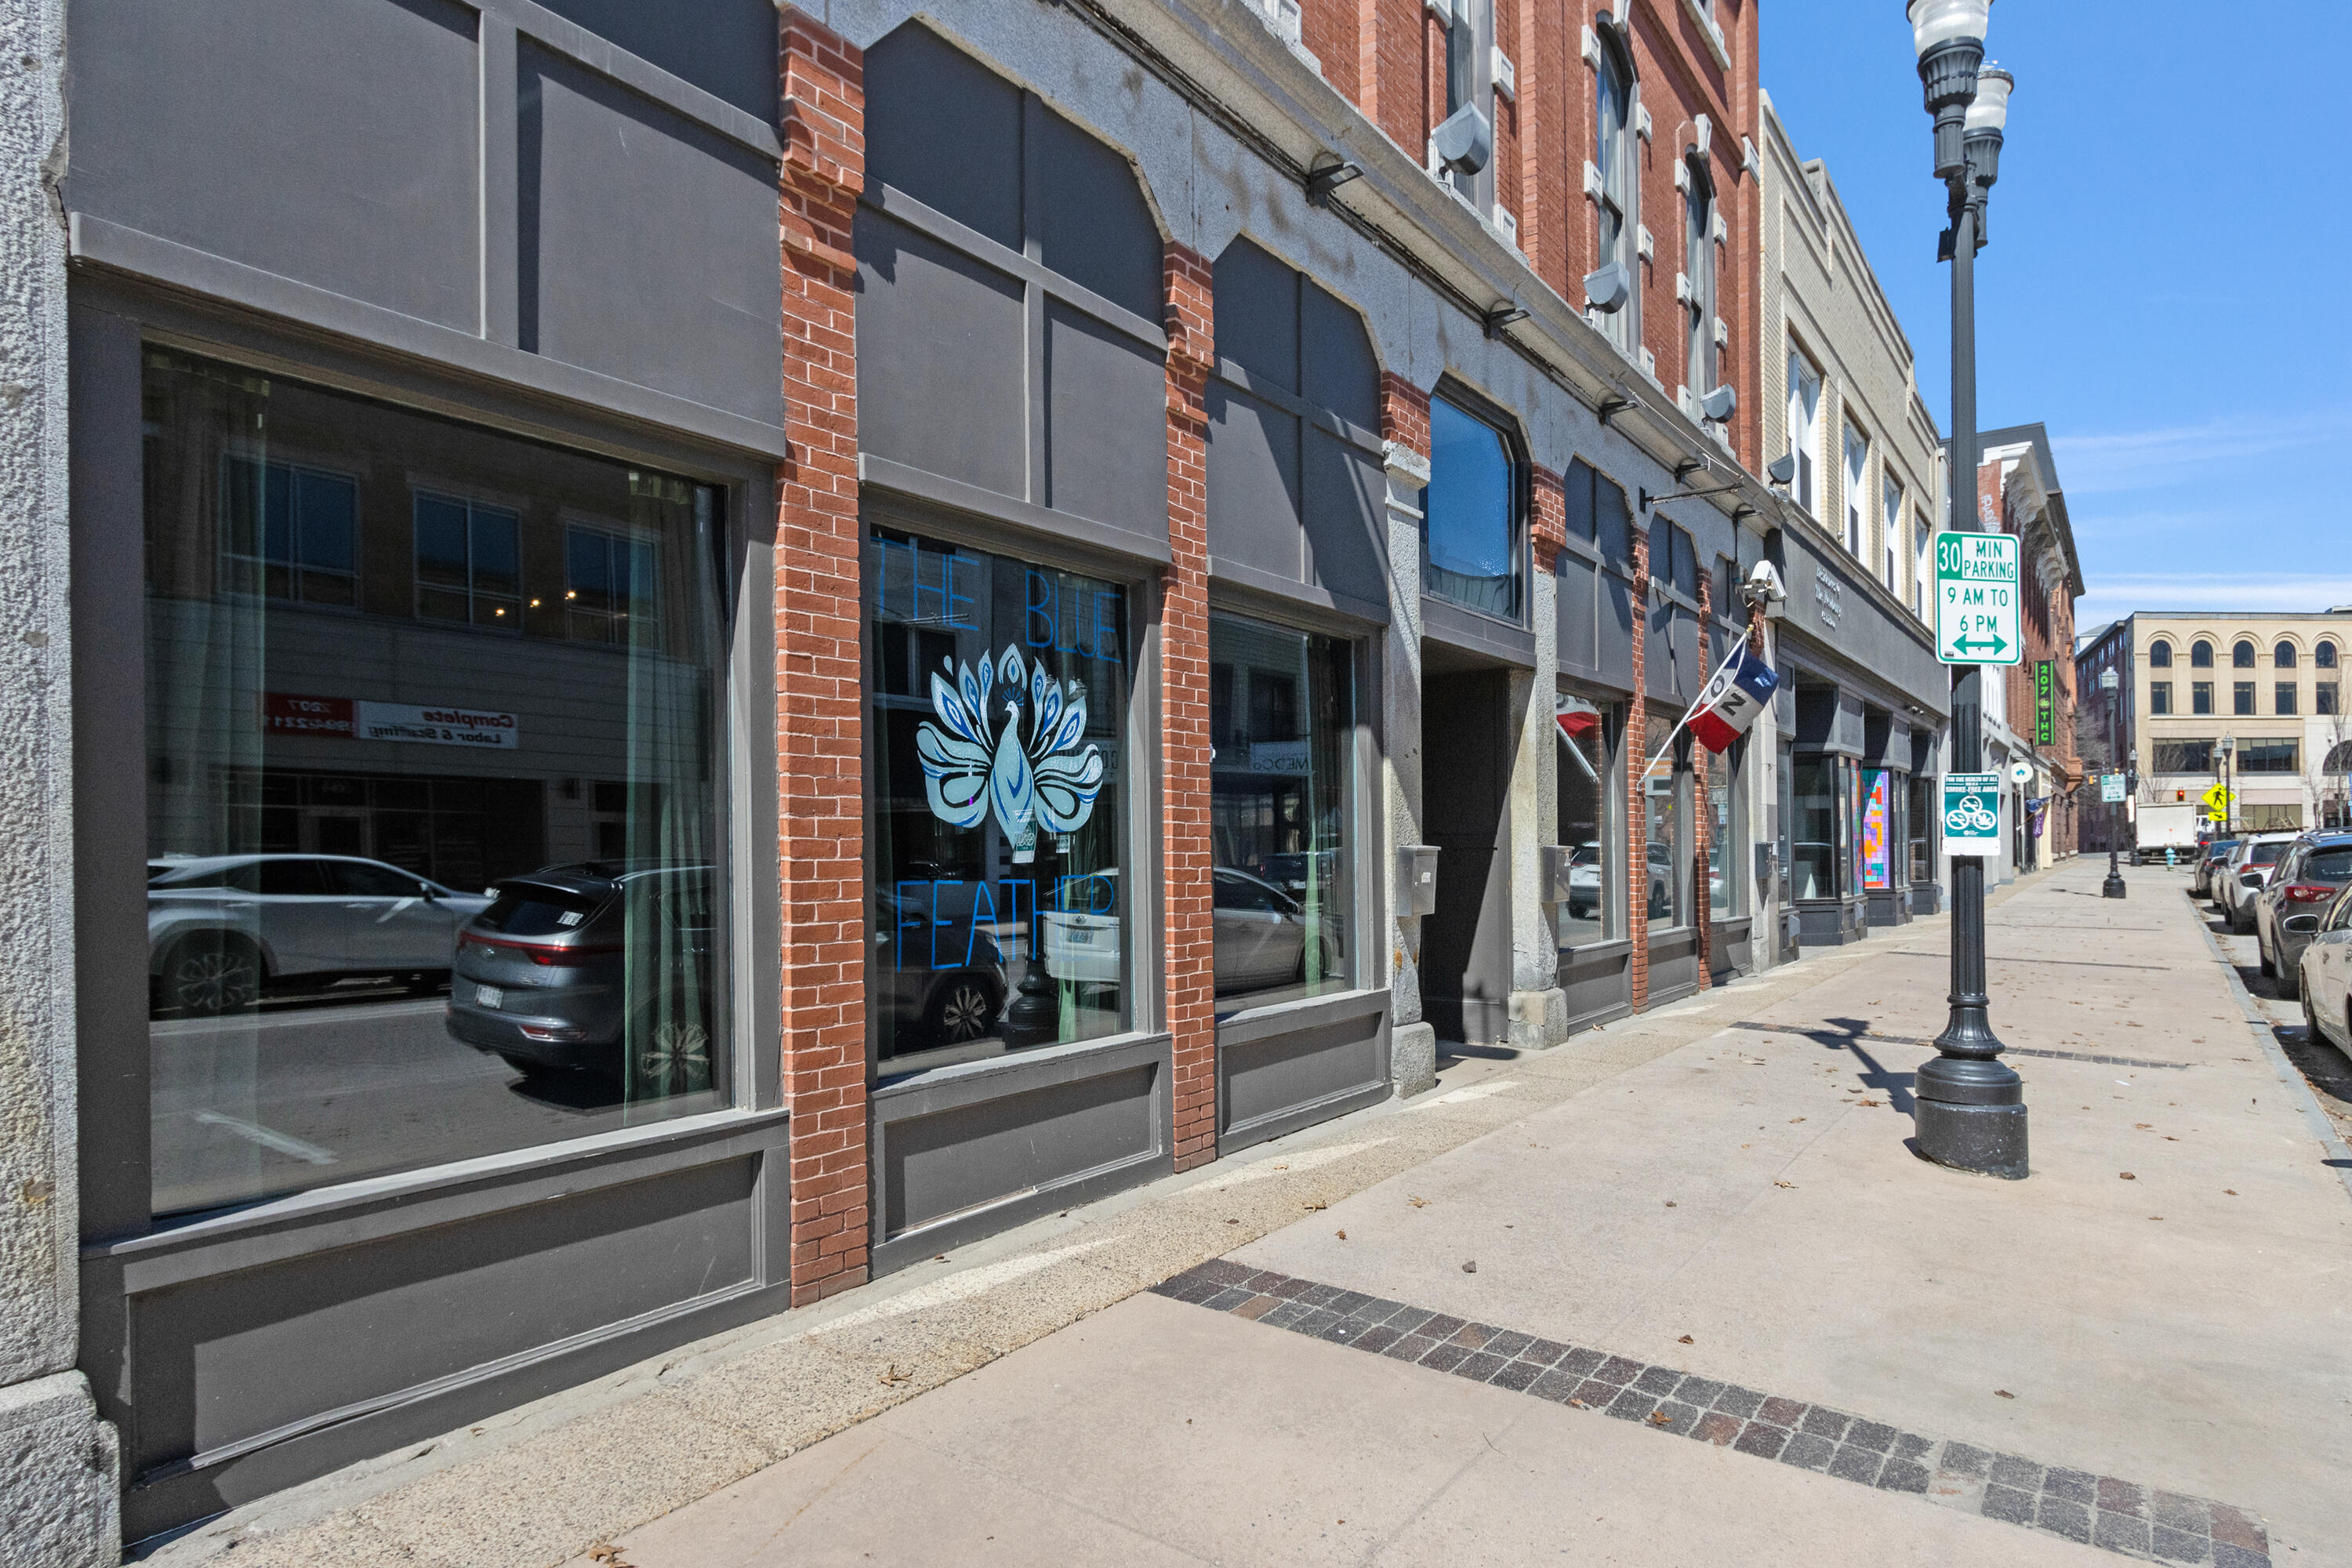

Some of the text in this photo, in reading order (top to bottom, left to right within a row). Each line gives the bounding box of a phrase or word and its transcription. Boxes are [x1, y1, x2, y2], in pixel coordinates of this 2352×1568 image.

[1939, 542, 1960, 572] 30
[1976, 540, 2002, 558] MIN
[1964, 560, 2013, 579] PARKING
[869, 536, 1122, 664] THE BLUE
[1947, 586, 2008, 607] 9 AM TO
[1959, 615, 1997, 633] 6 PM
[2040, 664, 2049, 695] 207
[2040, 711, 2049, 742] THC
